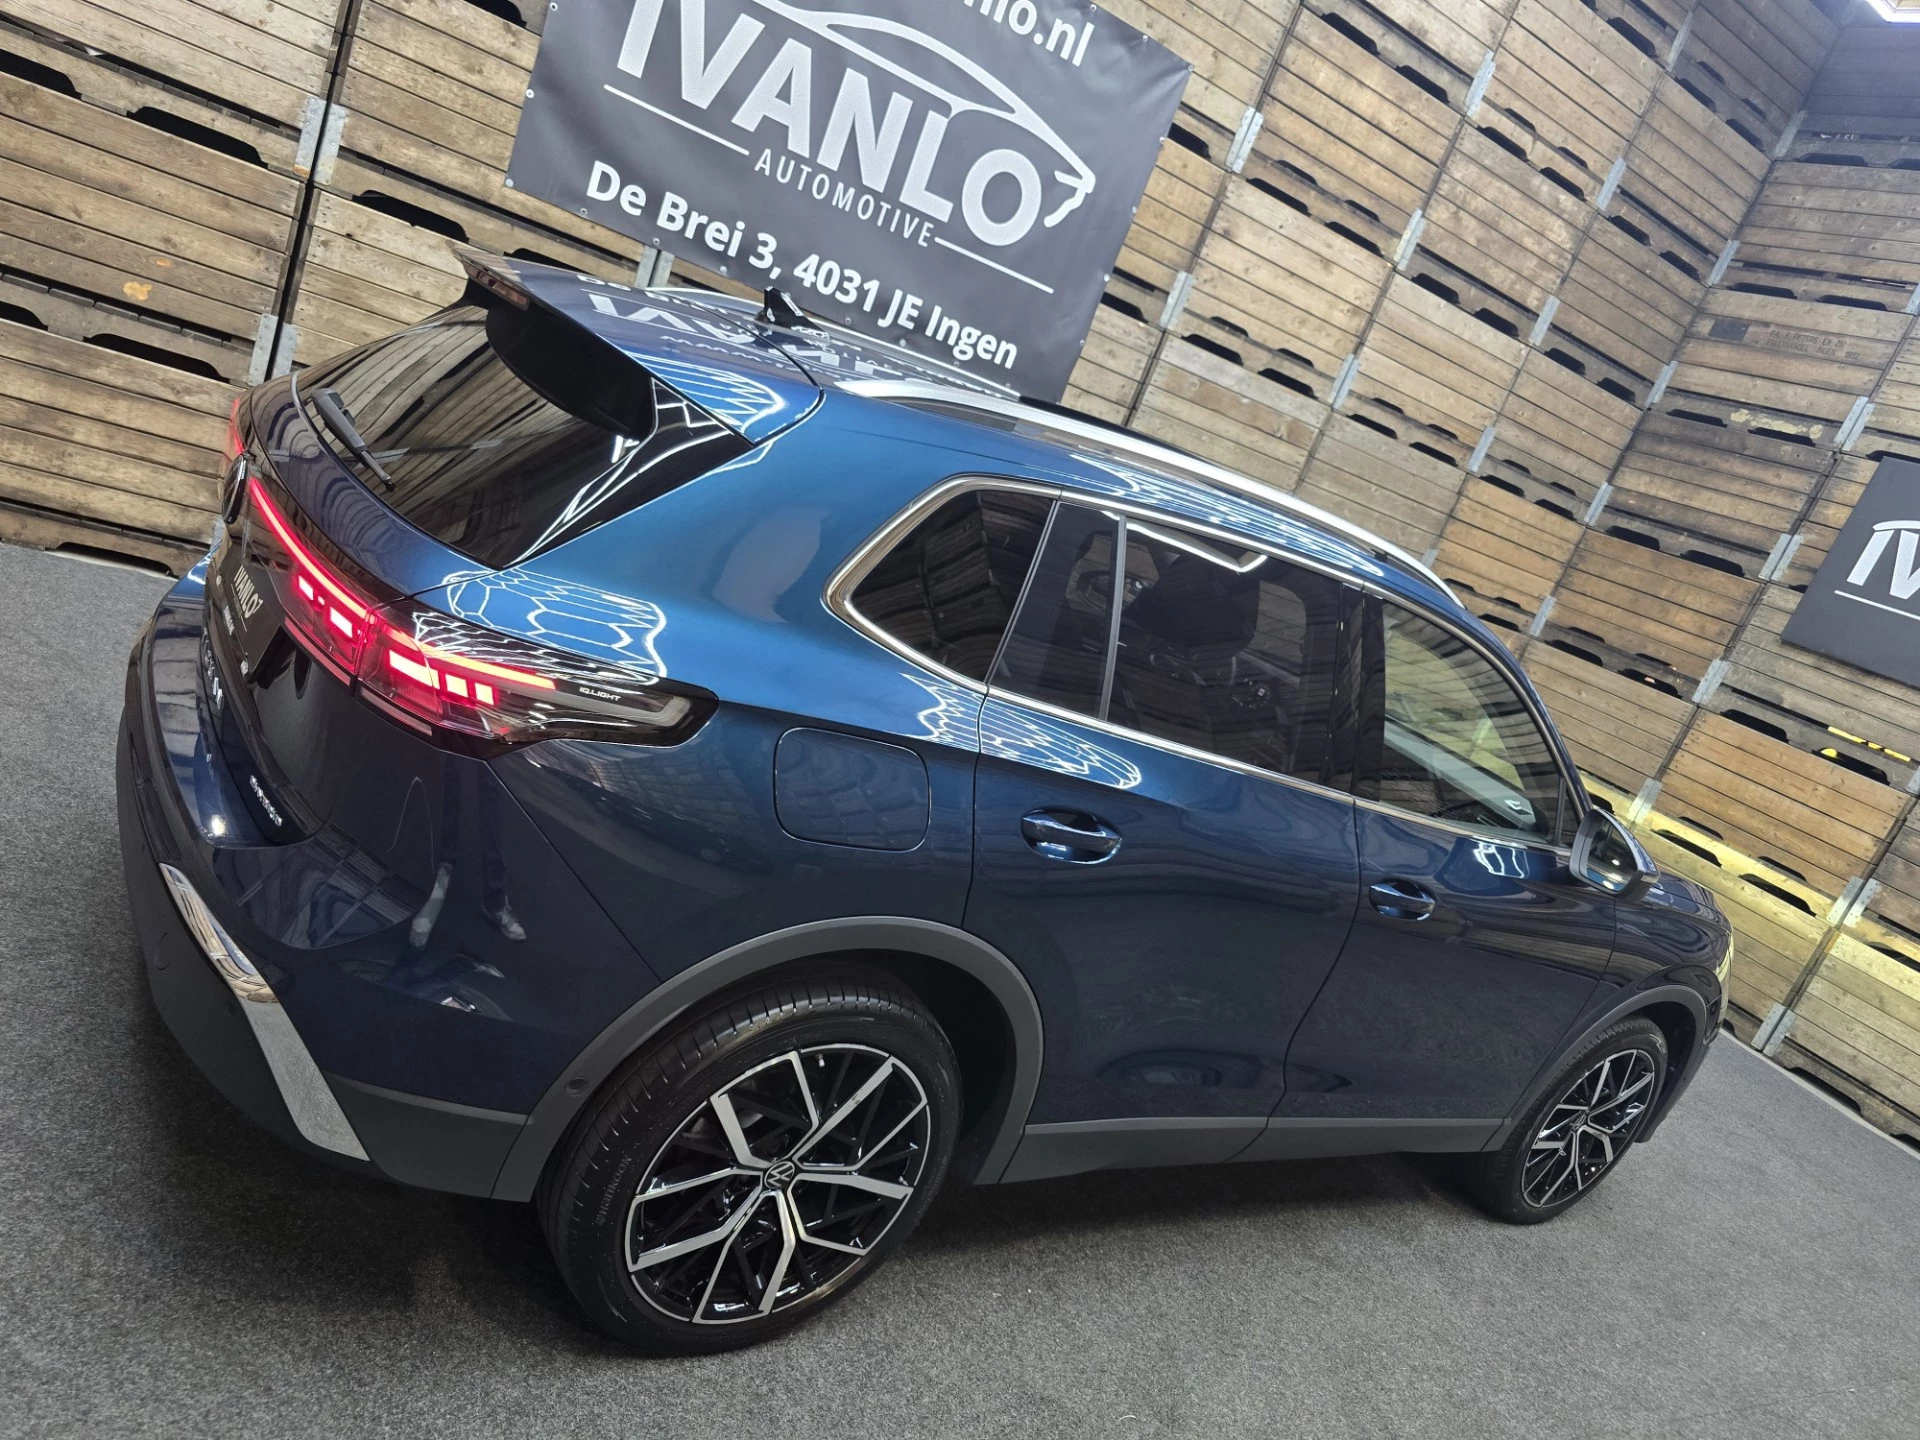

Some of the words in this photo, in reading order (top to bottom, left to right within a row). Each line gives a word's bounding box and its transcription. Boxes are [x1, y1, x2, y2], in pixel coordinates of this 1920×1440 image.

[616, 0, 1042, 246] IVANLO
[754, 148, 934, 248] AUTOMOTIVE
[587, 160, 646, 216] De
[656, 191, 746, 252] Brei
[748, 232, 782, 280] 3,
[793, 253, 880, 312] 4031
[877, 288, 924, 330] JE
[925, 305, 1018, 369] Ingen
